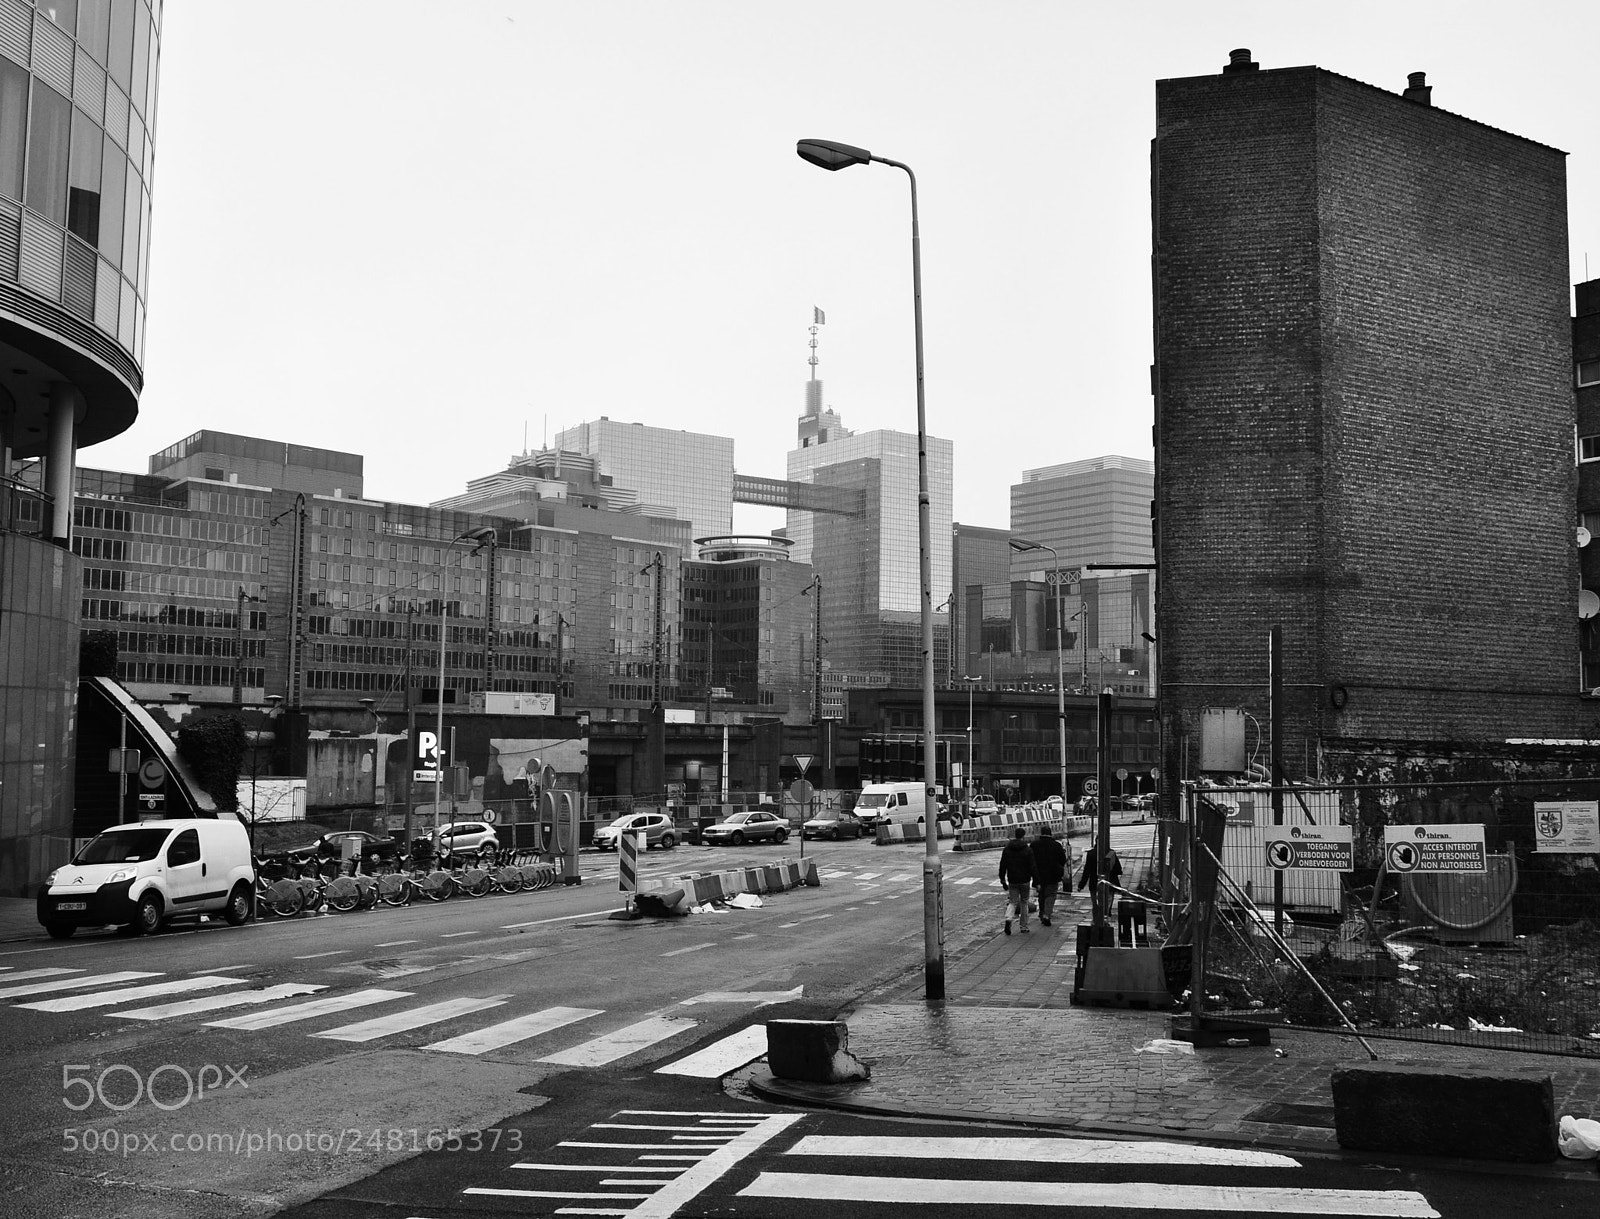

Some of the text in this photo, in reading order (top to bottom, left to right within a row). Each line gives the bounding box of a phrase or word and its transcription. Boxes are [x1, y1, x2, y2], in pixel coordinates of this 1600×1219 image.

[419, 732, 436, 758] P
[1086, 783, 1097, 791] 30
[1422, 843, 1478, 851] ACCES INTERDIT
[1296, 851, 1330, 859] VERBODEN
[1421, 852, 1480, 860] AUX PERSONNES
[1298, 860, 1348, 868] ONBEVOEGDEN
[1420, 861, 1482, 869] NON AUTORISEES
